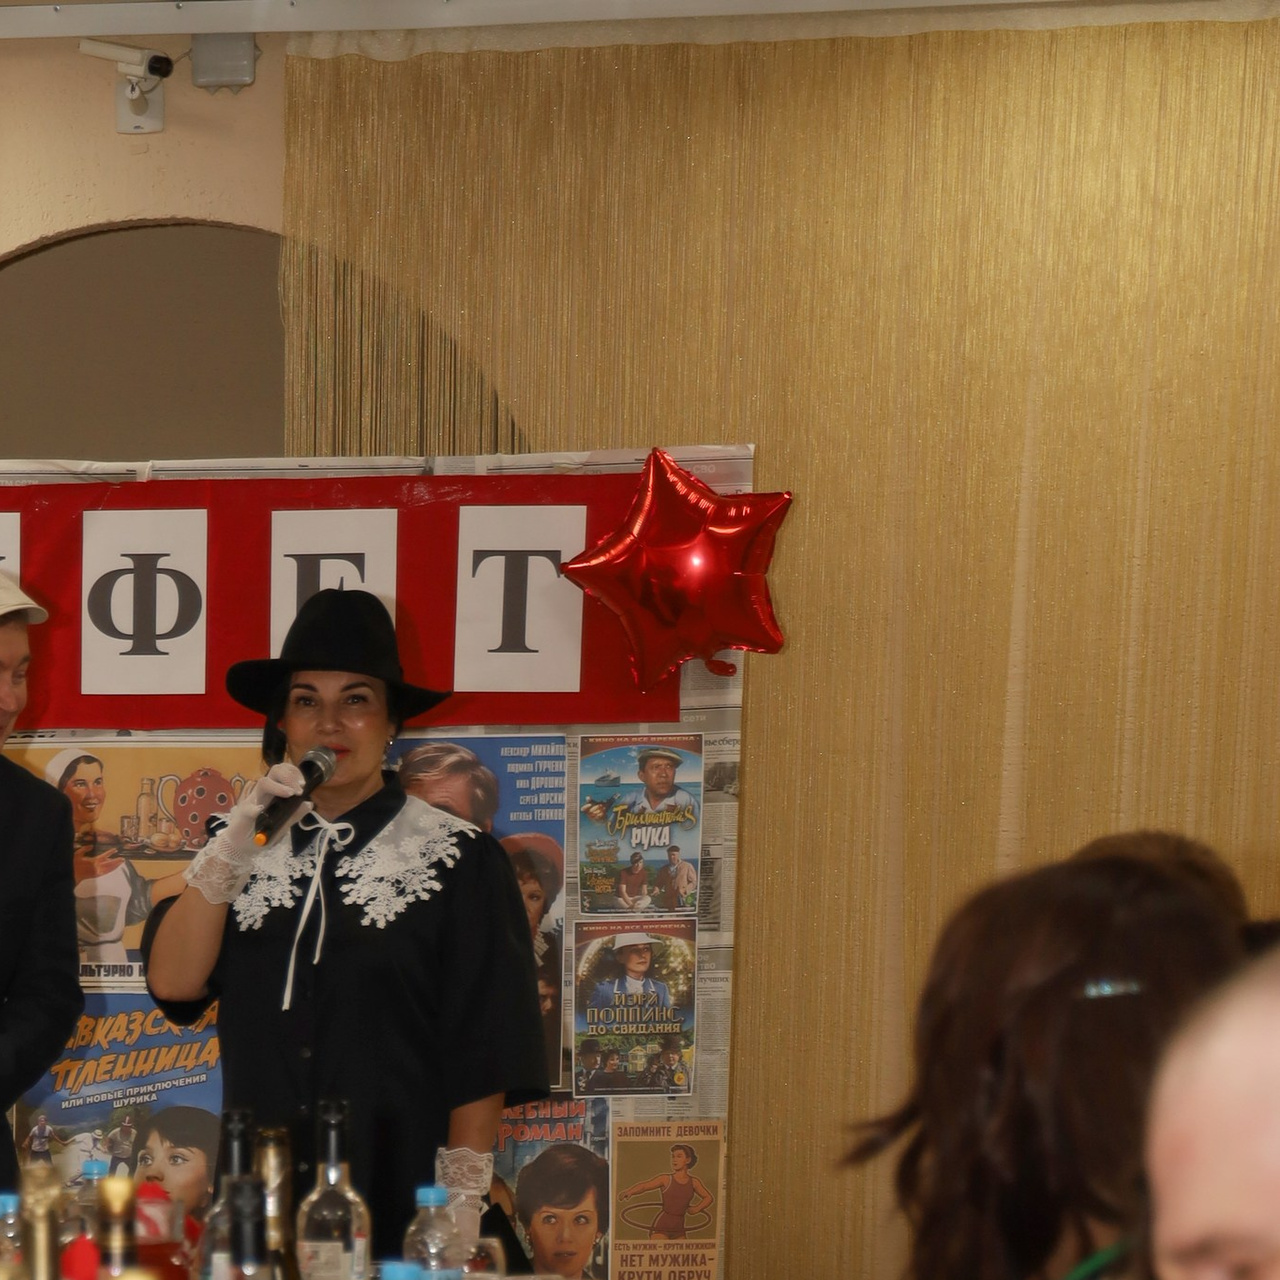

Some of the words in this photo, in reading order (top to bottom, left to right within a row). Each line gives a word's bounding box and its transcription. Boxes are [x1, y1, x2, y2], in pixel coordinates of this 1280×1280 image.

[531, 742, 566, 757] МИХАЙЛО
[631, 826, 670, 850] РУКА
[80, 964, 134, 977] ЛЬТУРНО
[587, 1024, 606, 1035] ДО
[612, 1022, 681, 1035] СВИДАНИЯ
[51, 1036, 221, 1096] ПЛЕННИЦА
[61, 1098, 84, 1110] ИЛИ
[86, 1089, 124, 1104] НОВЫЕ
[126, 1074, 208, 1096] ПРИКЛЮЧЕНИЯ
[112, 1094, 158, 1109] ШУРИКА
[498, 1122, 584, 1152] РОМАН
[617, 1125, 672, 1138] ЗАПОМНИТЕ
[675, 1124, 719, 1138] ДЕВОЧКИ
[614, 1243, 631, 1251] ЕСТЬ
[632, 1243, 658, 1251] МУЖИК
[663, 1242, 684, 1250] КРУТИ
[620, 1254, 645, 1267] НЕТ
